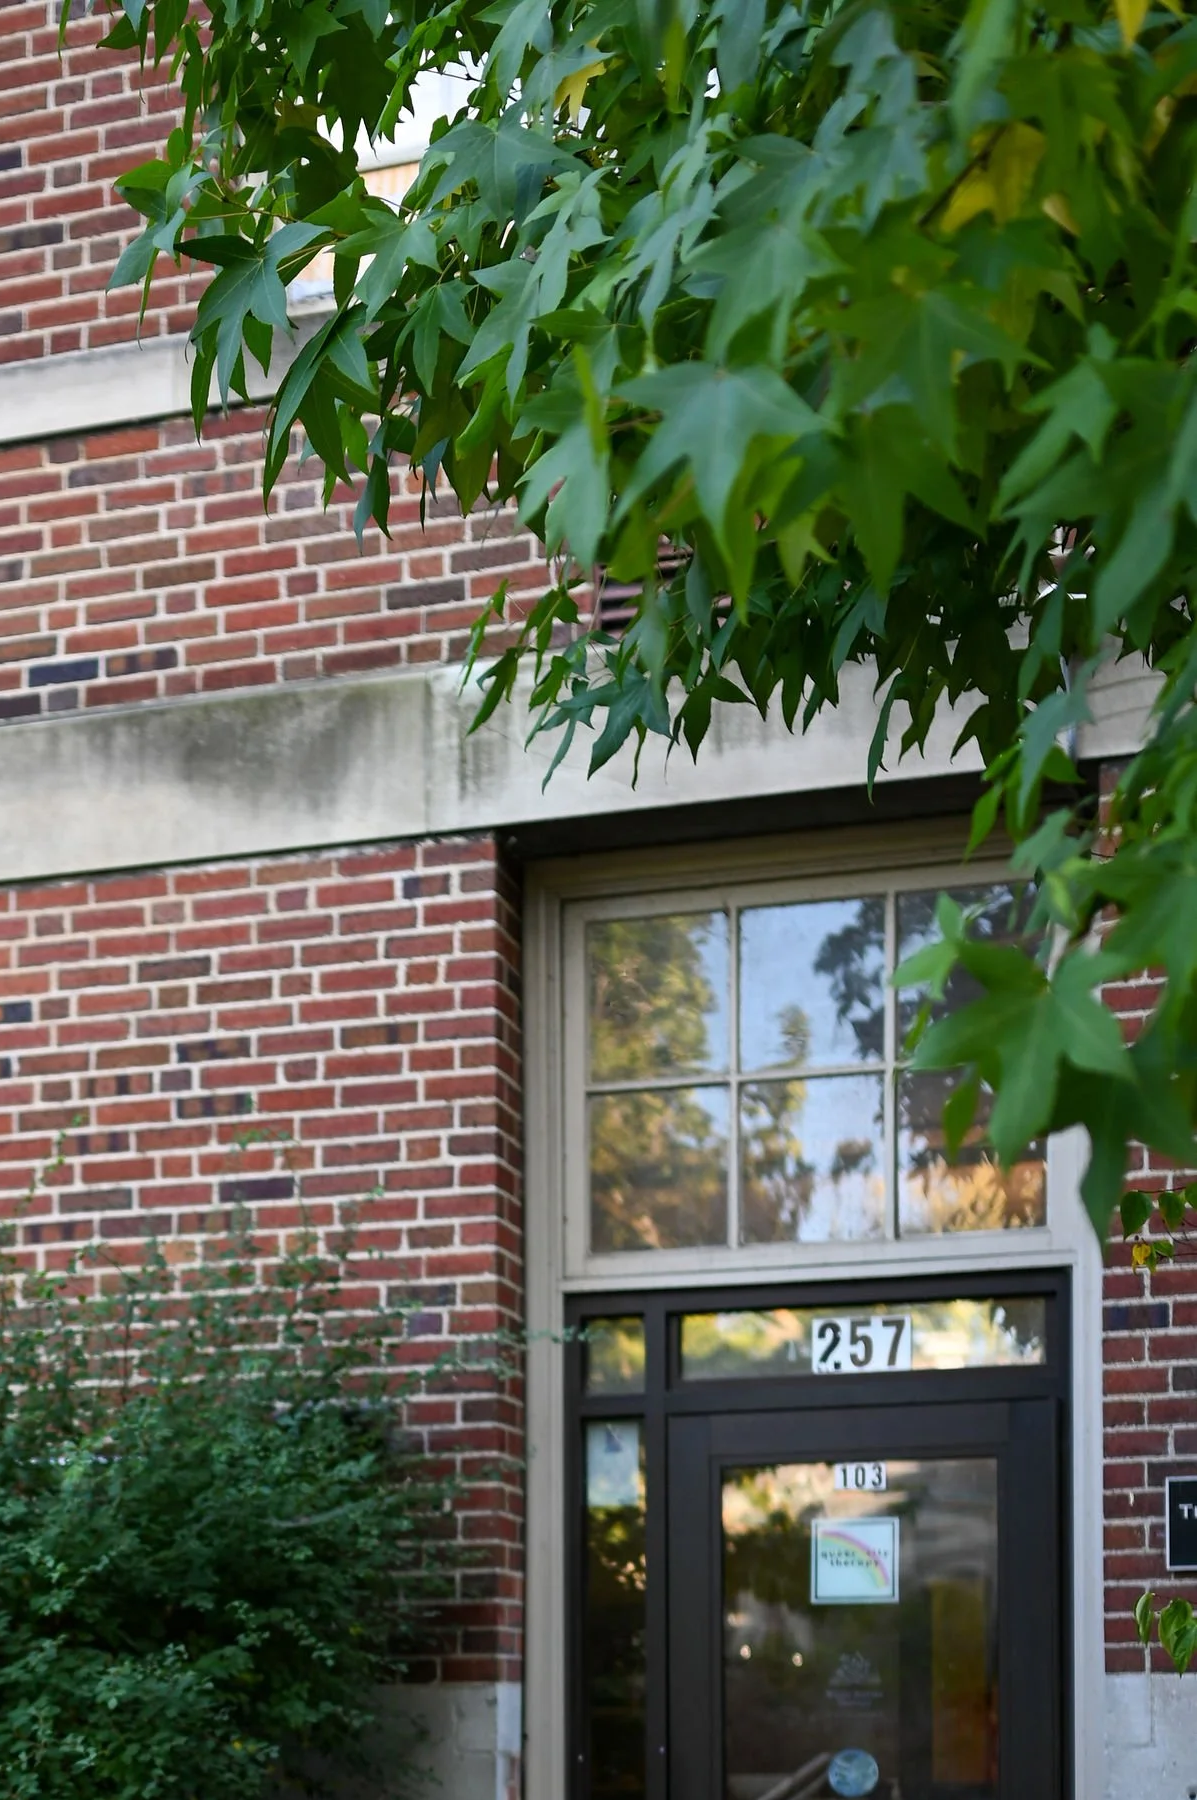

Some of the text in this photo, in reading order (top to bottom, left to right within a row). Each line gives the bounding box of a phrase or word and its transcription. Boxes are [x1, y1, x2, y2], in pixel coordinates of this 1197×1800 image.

[818, 1318, 906, 1370] 257
[841, 1463, 882, 1488] 103
[830, 1558, 879, 1568] therapy
